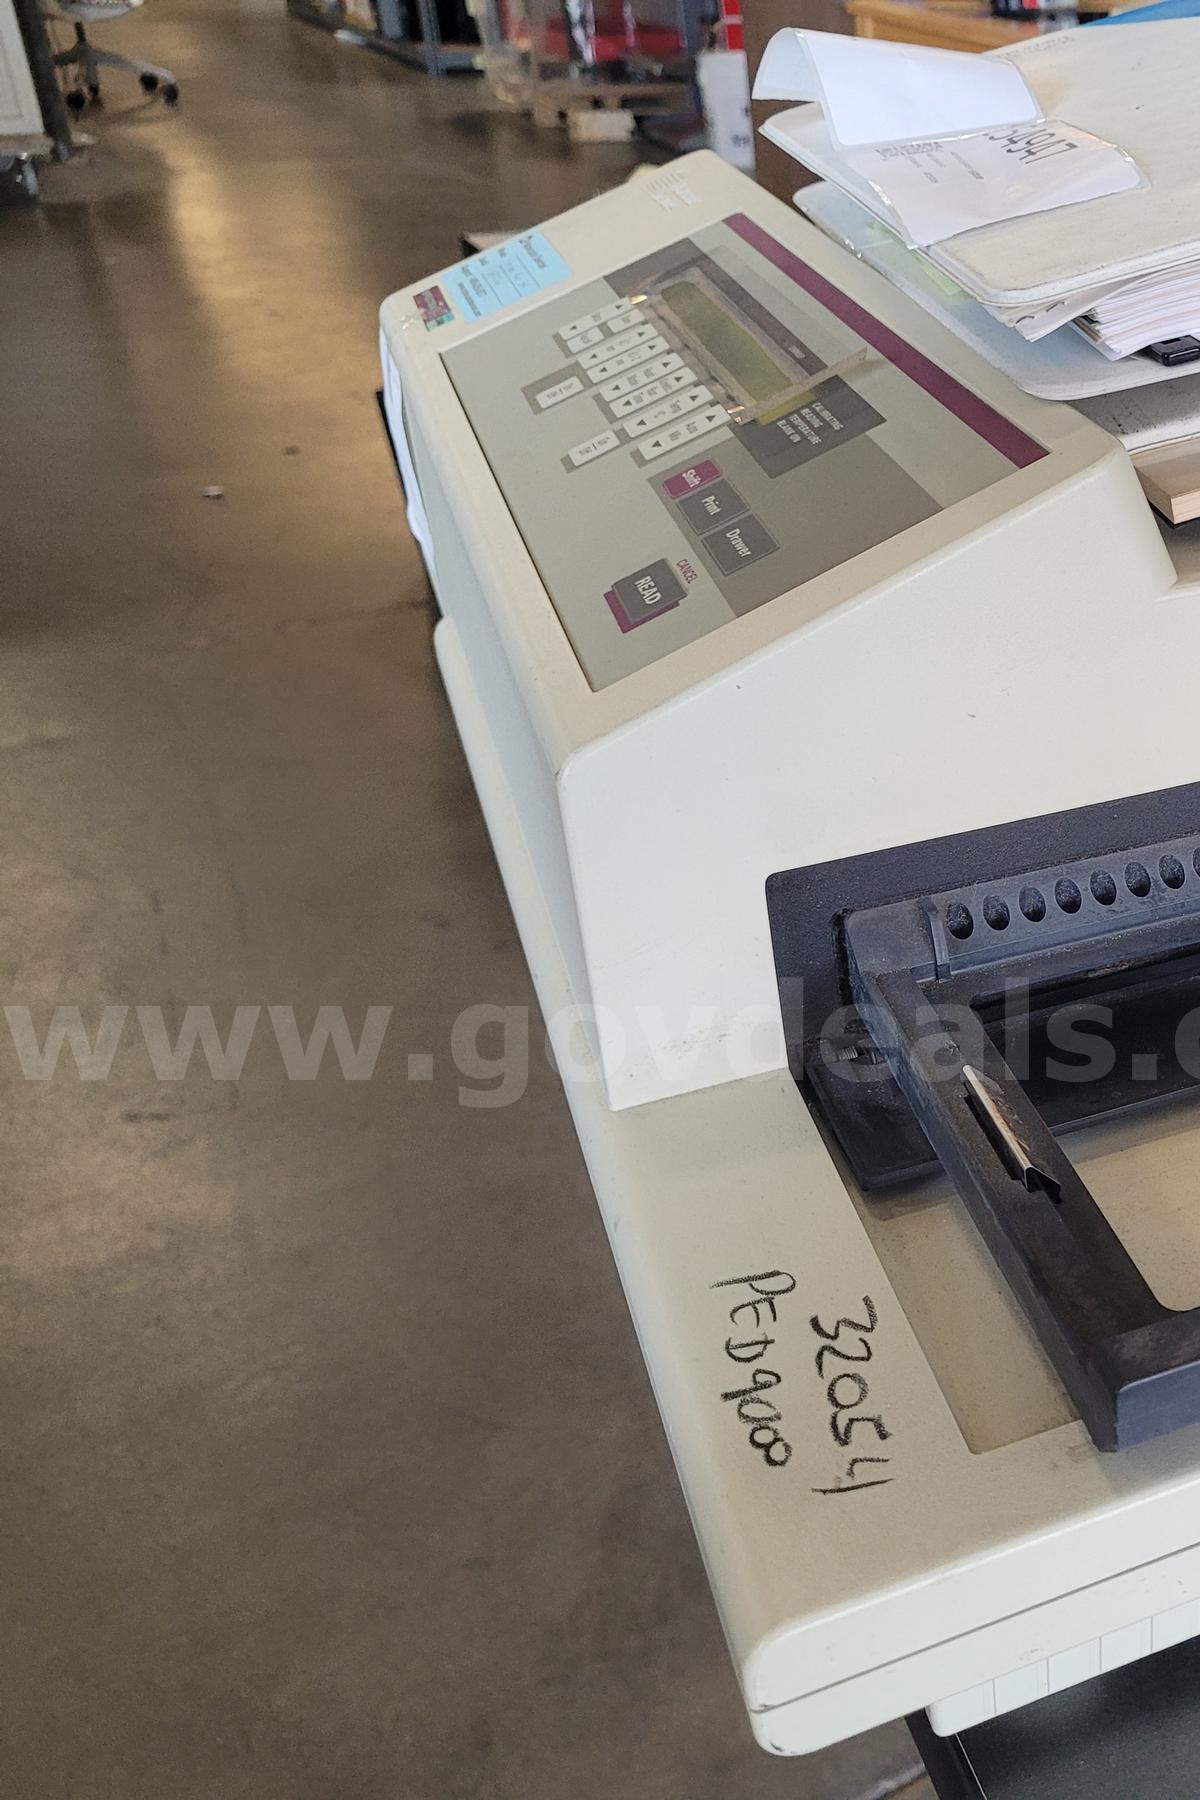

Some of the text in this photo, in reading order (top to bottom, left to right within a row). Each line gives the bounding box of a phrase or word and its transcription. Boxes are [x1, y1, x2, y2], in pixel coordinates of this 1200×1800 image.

[776, 420, 796, 436] BLANK
[789, 414, 822, 445] TEMPERATURE
[801, 408, 824, 428] READING
[812, 402, 844, 430] CALIBRATING
[701, 495, 722, 516] Print
[726, 528, 752, 558] Drawer
[676, 558, 698, 584] CANCEL
[634, 575, 662, 605] READ
